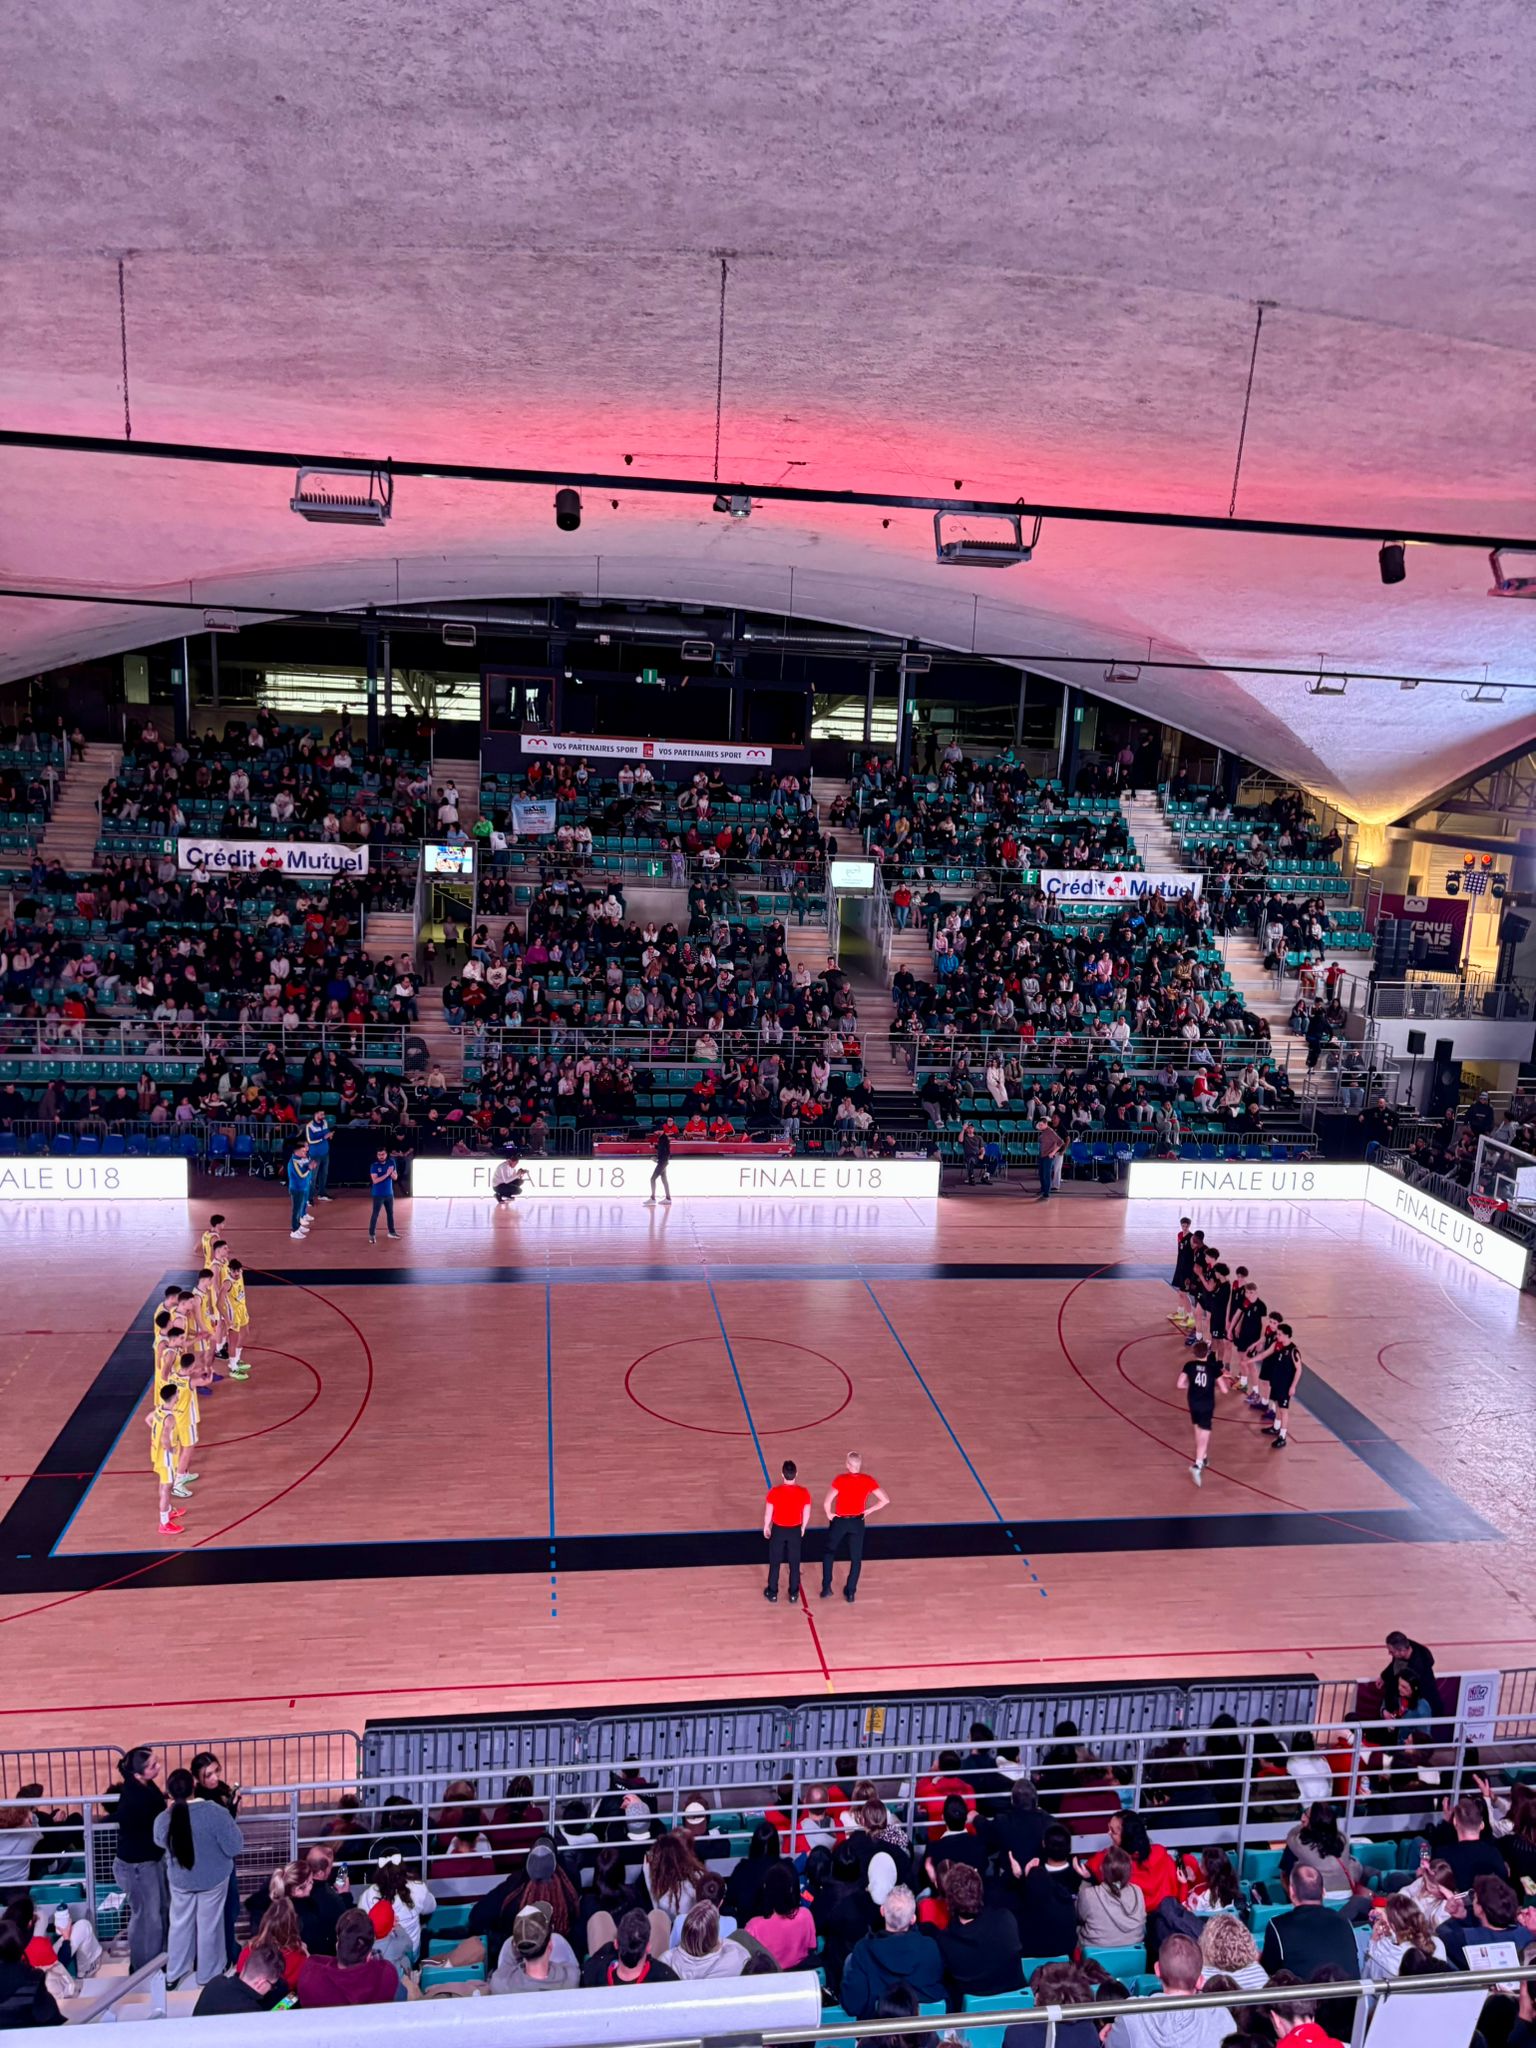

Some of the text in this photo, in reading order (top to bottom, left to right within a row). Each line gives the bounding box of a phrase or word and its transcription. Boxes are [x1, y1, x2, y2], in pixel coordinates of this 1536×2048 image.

[552, 742, 567, 750] VOS
[568, 743, 614, 752] PARTENAIRES
[616, 746, 638, 754] SPORT
[673, 749, 719, 758] PARTENAIRES
[720, 751, 742, 759] SPORT
[186, 847, 363, 870] Crédit Mutuel
[1027, 871, 1034, 883] E
[1046, 877, 1196, 897] Crédit Mutuel
[66, 1167, 120, 1189] U18
[473, 1167, 625, 1188] FIALE U18
[739, 1167, 882, 1188] FINALE U18
[1181, 1170, 1315, 1192] FINALE U18
[1395, 1188, 1484, 1255] FINALE U18
[1194, 1371, 1207, 1388] 40
